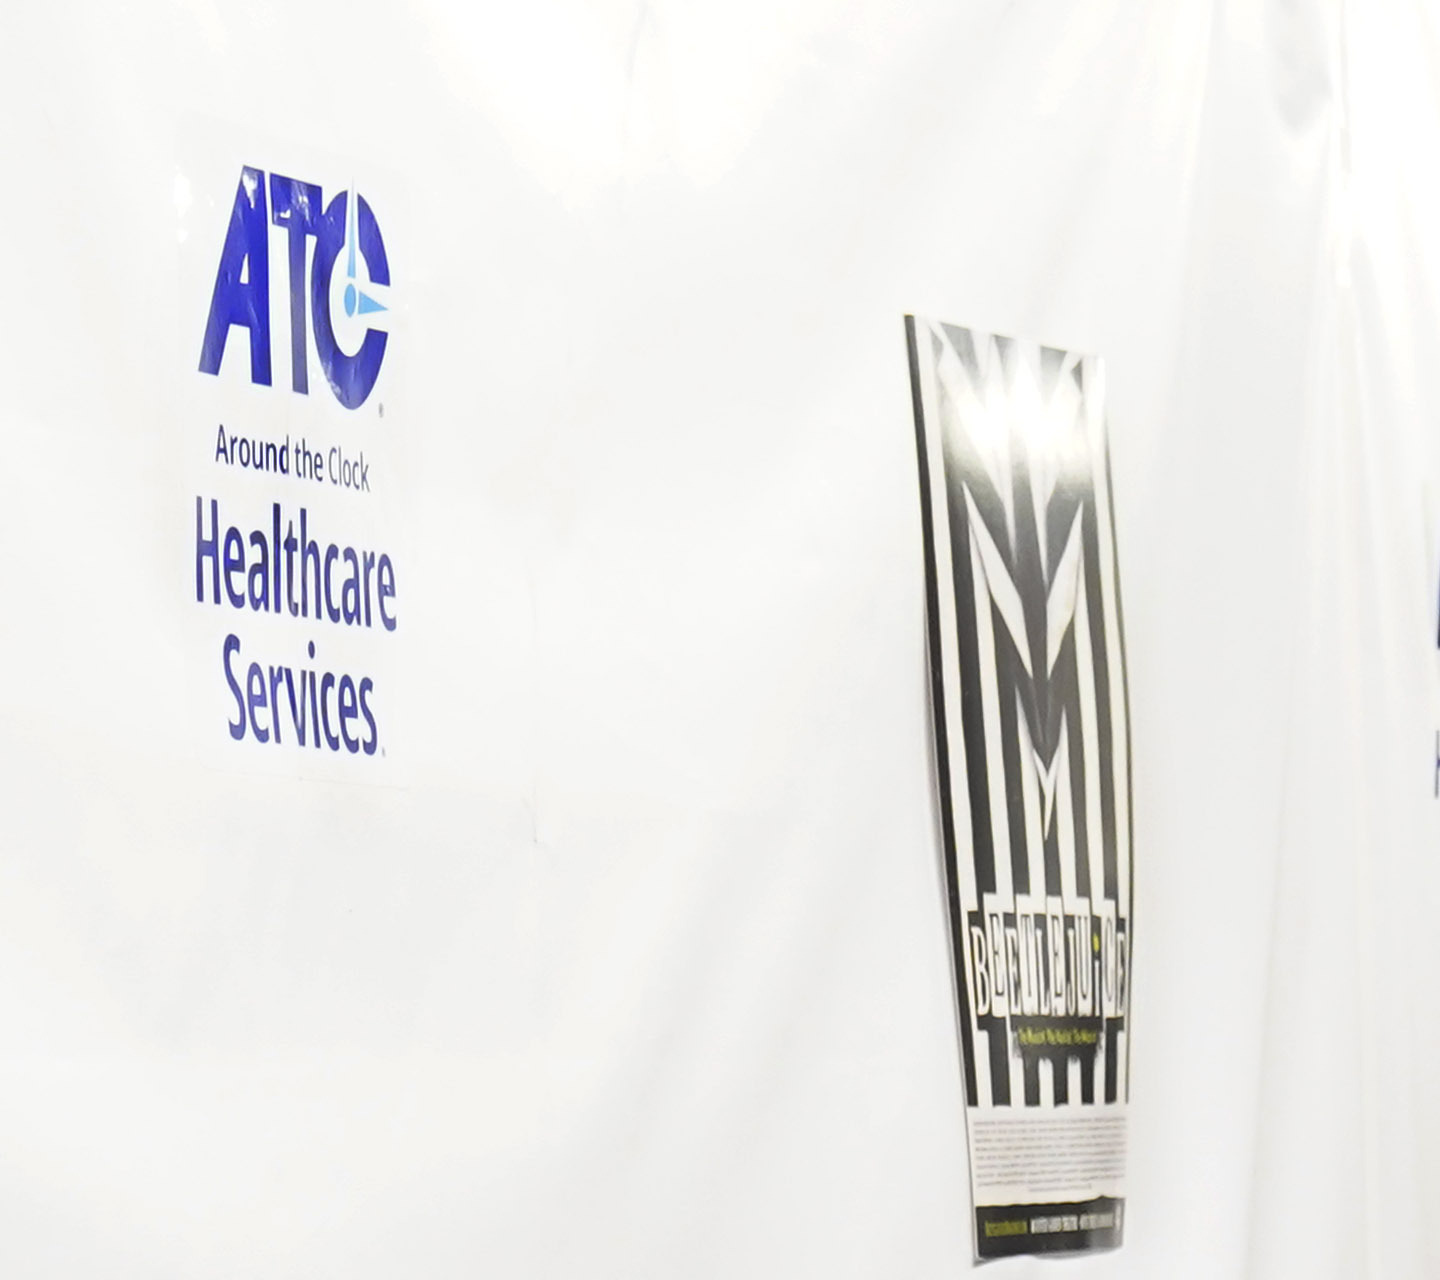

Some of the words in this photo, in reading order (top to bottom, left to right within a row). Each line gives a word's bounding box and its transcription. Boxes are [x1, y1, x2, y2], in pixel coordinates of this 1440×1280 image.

[198, 165, 391, 411] ATC
[215, 423, 290, 477] Around
[294, 438, 324, 484] the
[328, 445, 371, 493] Clock
[196, 495, 398, 632] Healthcare
[223, 633, 379, 756] Services
